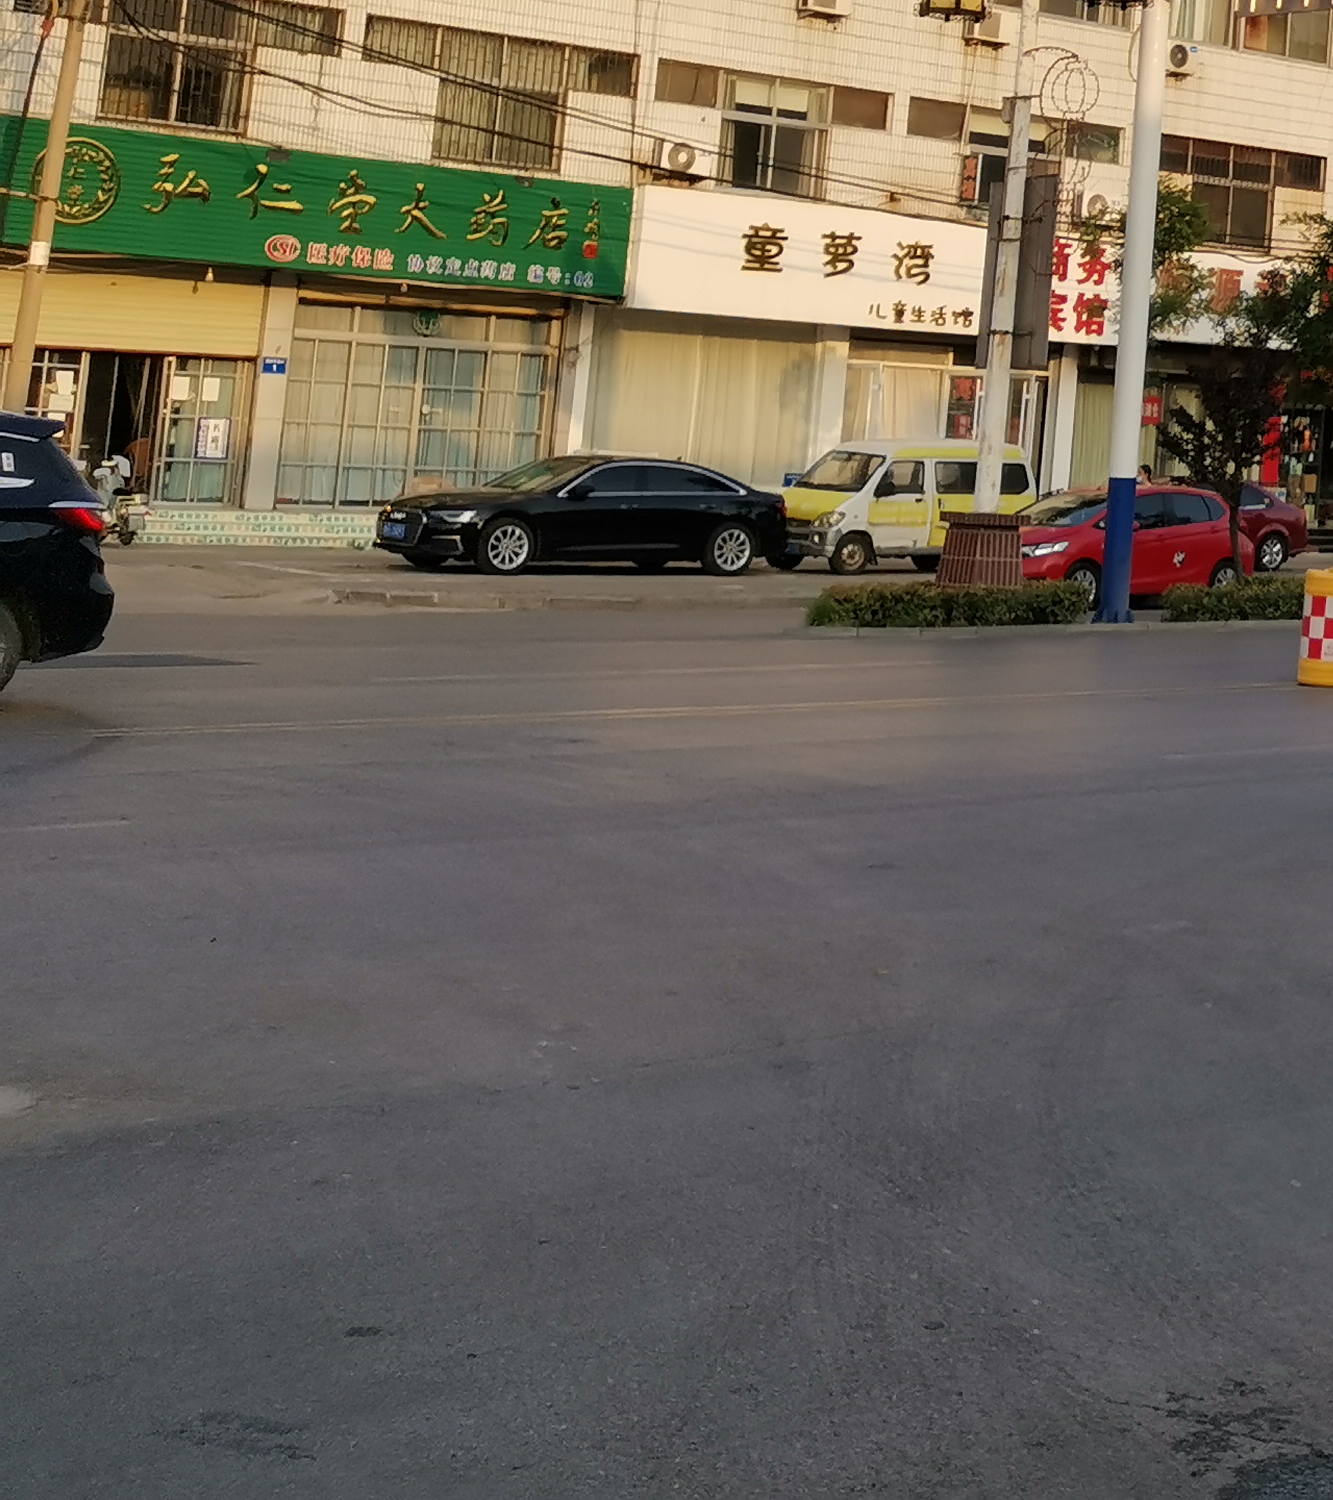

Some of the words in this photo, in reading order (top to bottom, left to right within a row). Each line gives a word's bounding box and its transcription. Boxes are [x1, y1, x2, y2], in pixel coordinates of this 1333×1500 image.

[141, 153, 570, 250] 弘仁堂大药店
[306, 241, 395, 271] 医疗保险
[869, 299, 975, 328] 儿童生活馆
